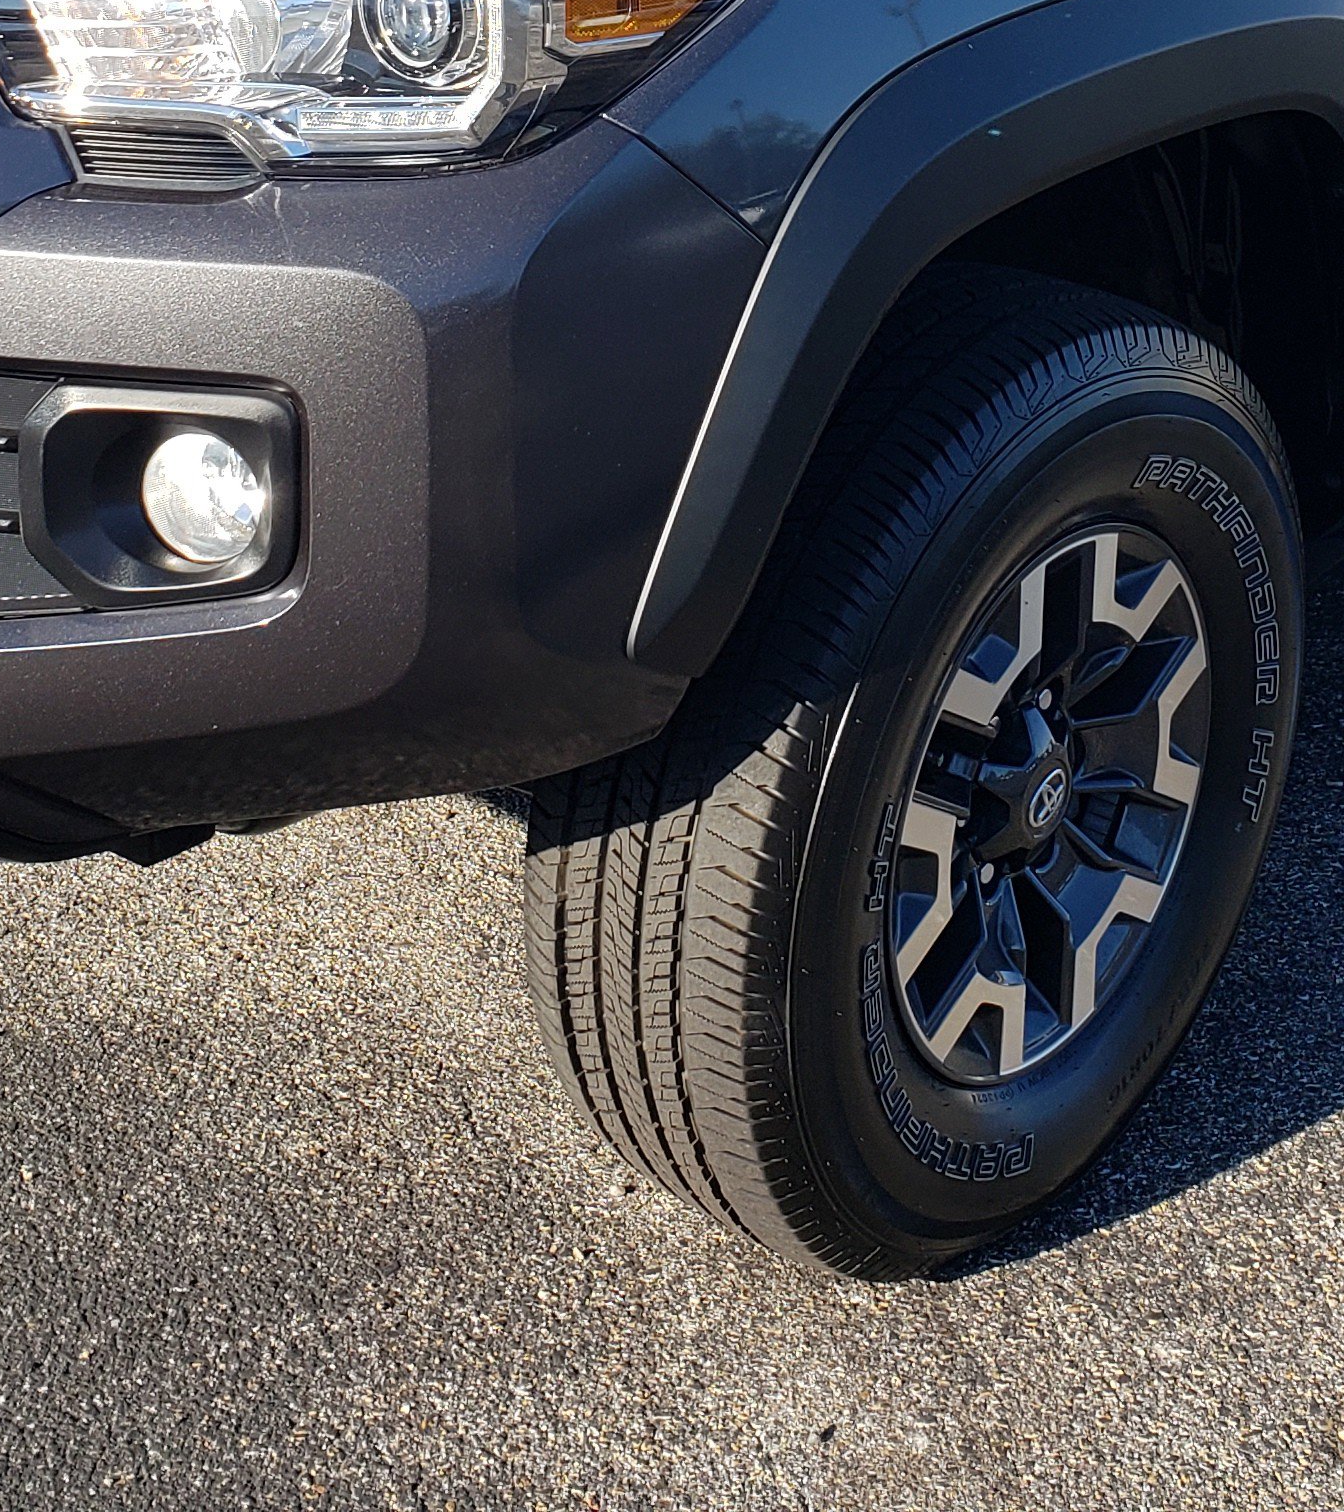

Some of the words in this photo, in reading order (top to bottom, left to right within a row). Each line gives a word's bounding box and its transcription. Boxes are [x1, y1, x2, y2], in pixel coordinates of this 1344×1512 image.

[1132, 453, 1281, 706] PATHFINDER
[1241, 728, 1276, 824] HT
[867, 802, 897, 913] HT
[859, 939, 1036, 1181] PATHFINDER
